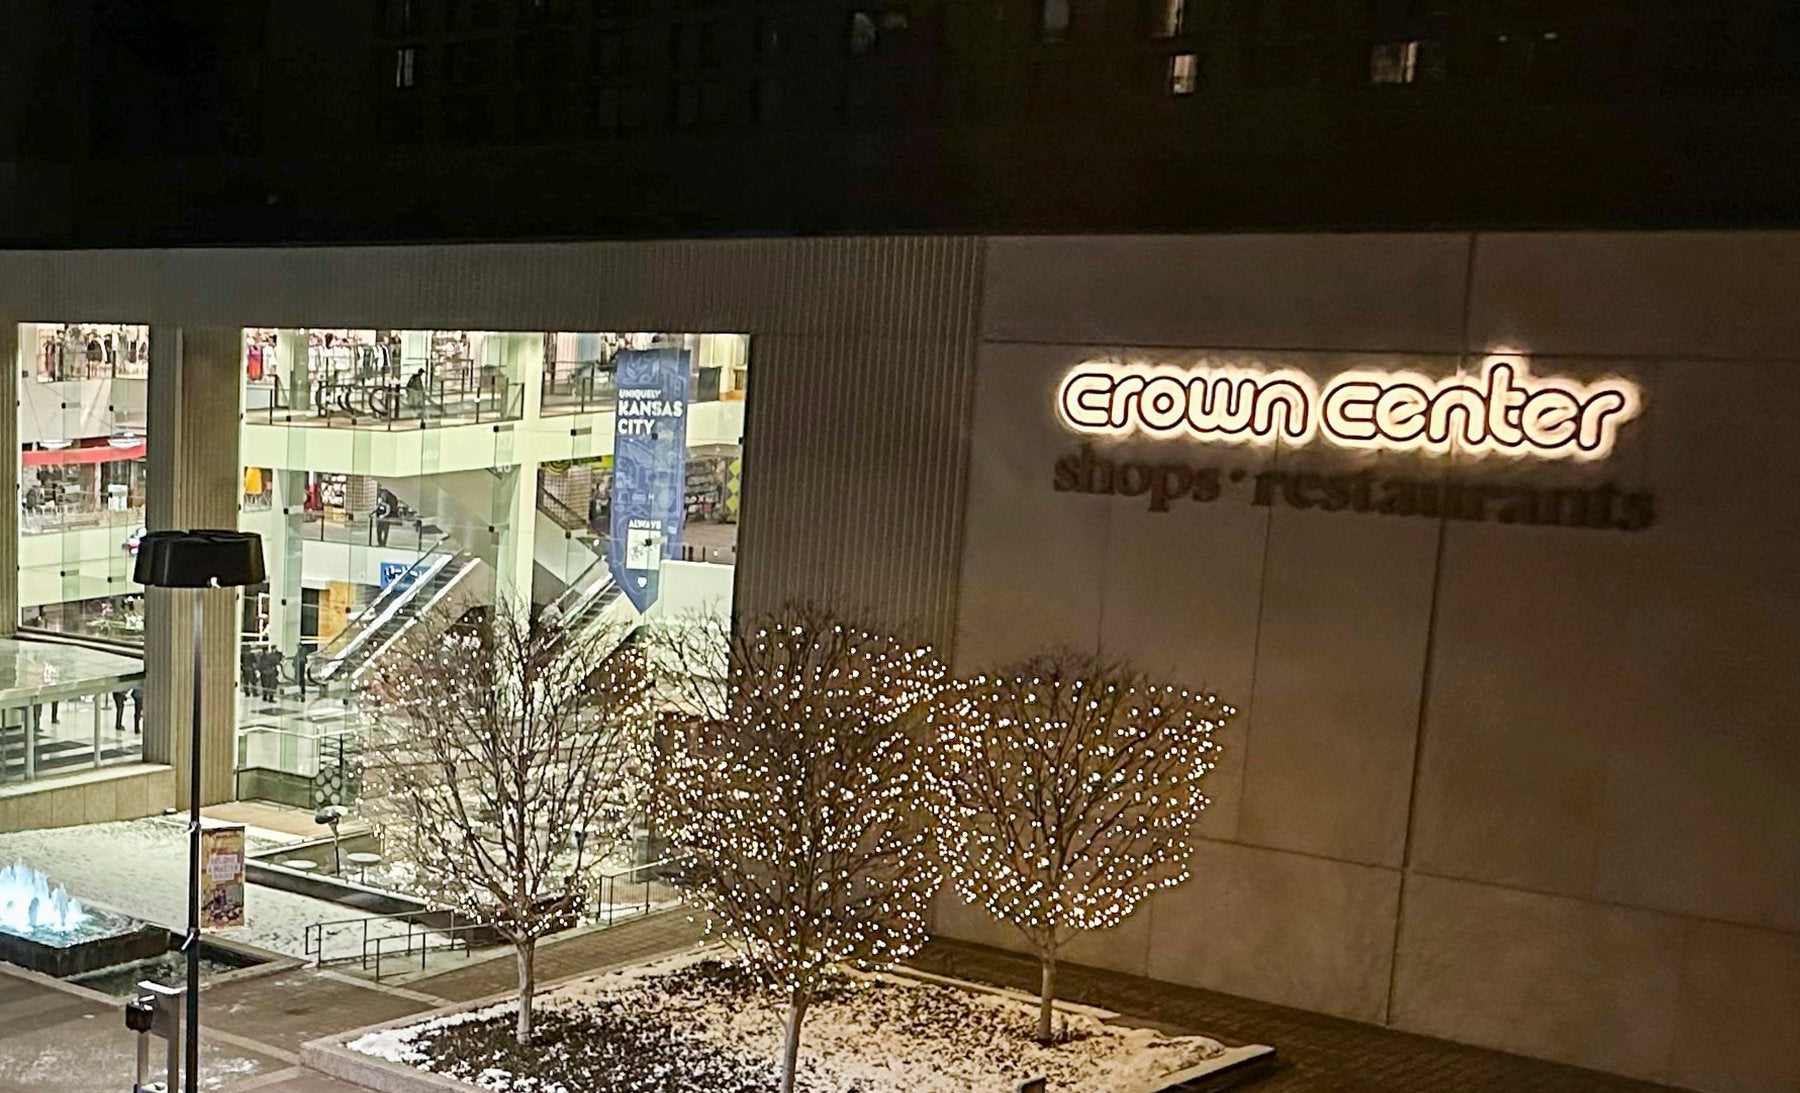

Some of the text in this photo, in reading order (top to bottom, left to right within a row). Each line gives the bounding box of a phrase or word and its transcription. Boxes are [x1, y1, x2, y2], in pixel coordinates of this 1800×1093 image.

[618, 389, 662, 401] UNIQUELY
[617, 400, 684, 418] KANSAS
[1061, 361, 1627, 452] crown center
[617, 418, 656, 436] CITY
[1053, 442, 1221, 513] shops
